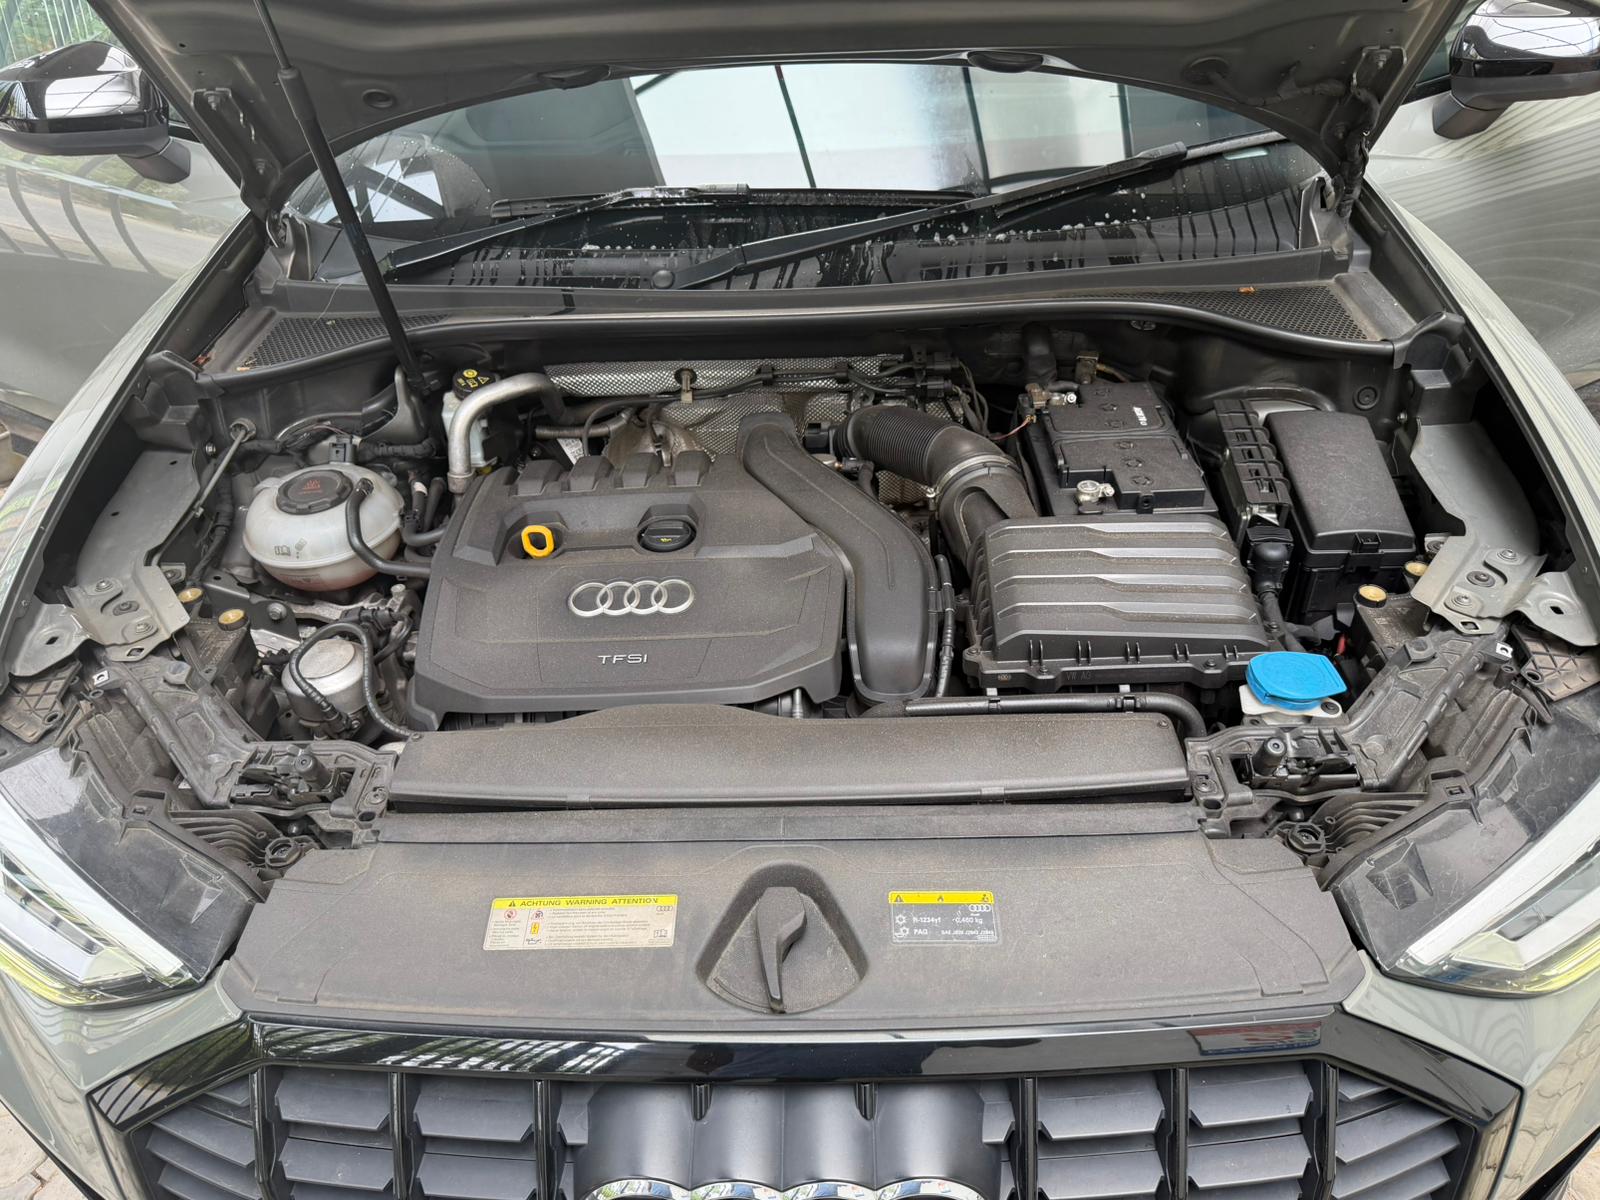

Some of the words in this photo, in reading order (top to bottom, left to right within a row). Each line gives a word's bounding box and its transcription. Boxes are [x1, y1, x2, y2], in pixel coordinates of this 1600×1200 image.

[597, 653, 649, 665] TFSI
[519, 899, 562, 907] ACHTUNG
[565, 898, 608, 906] WARNING
[611, 896, 659, 905] ATTENTION
